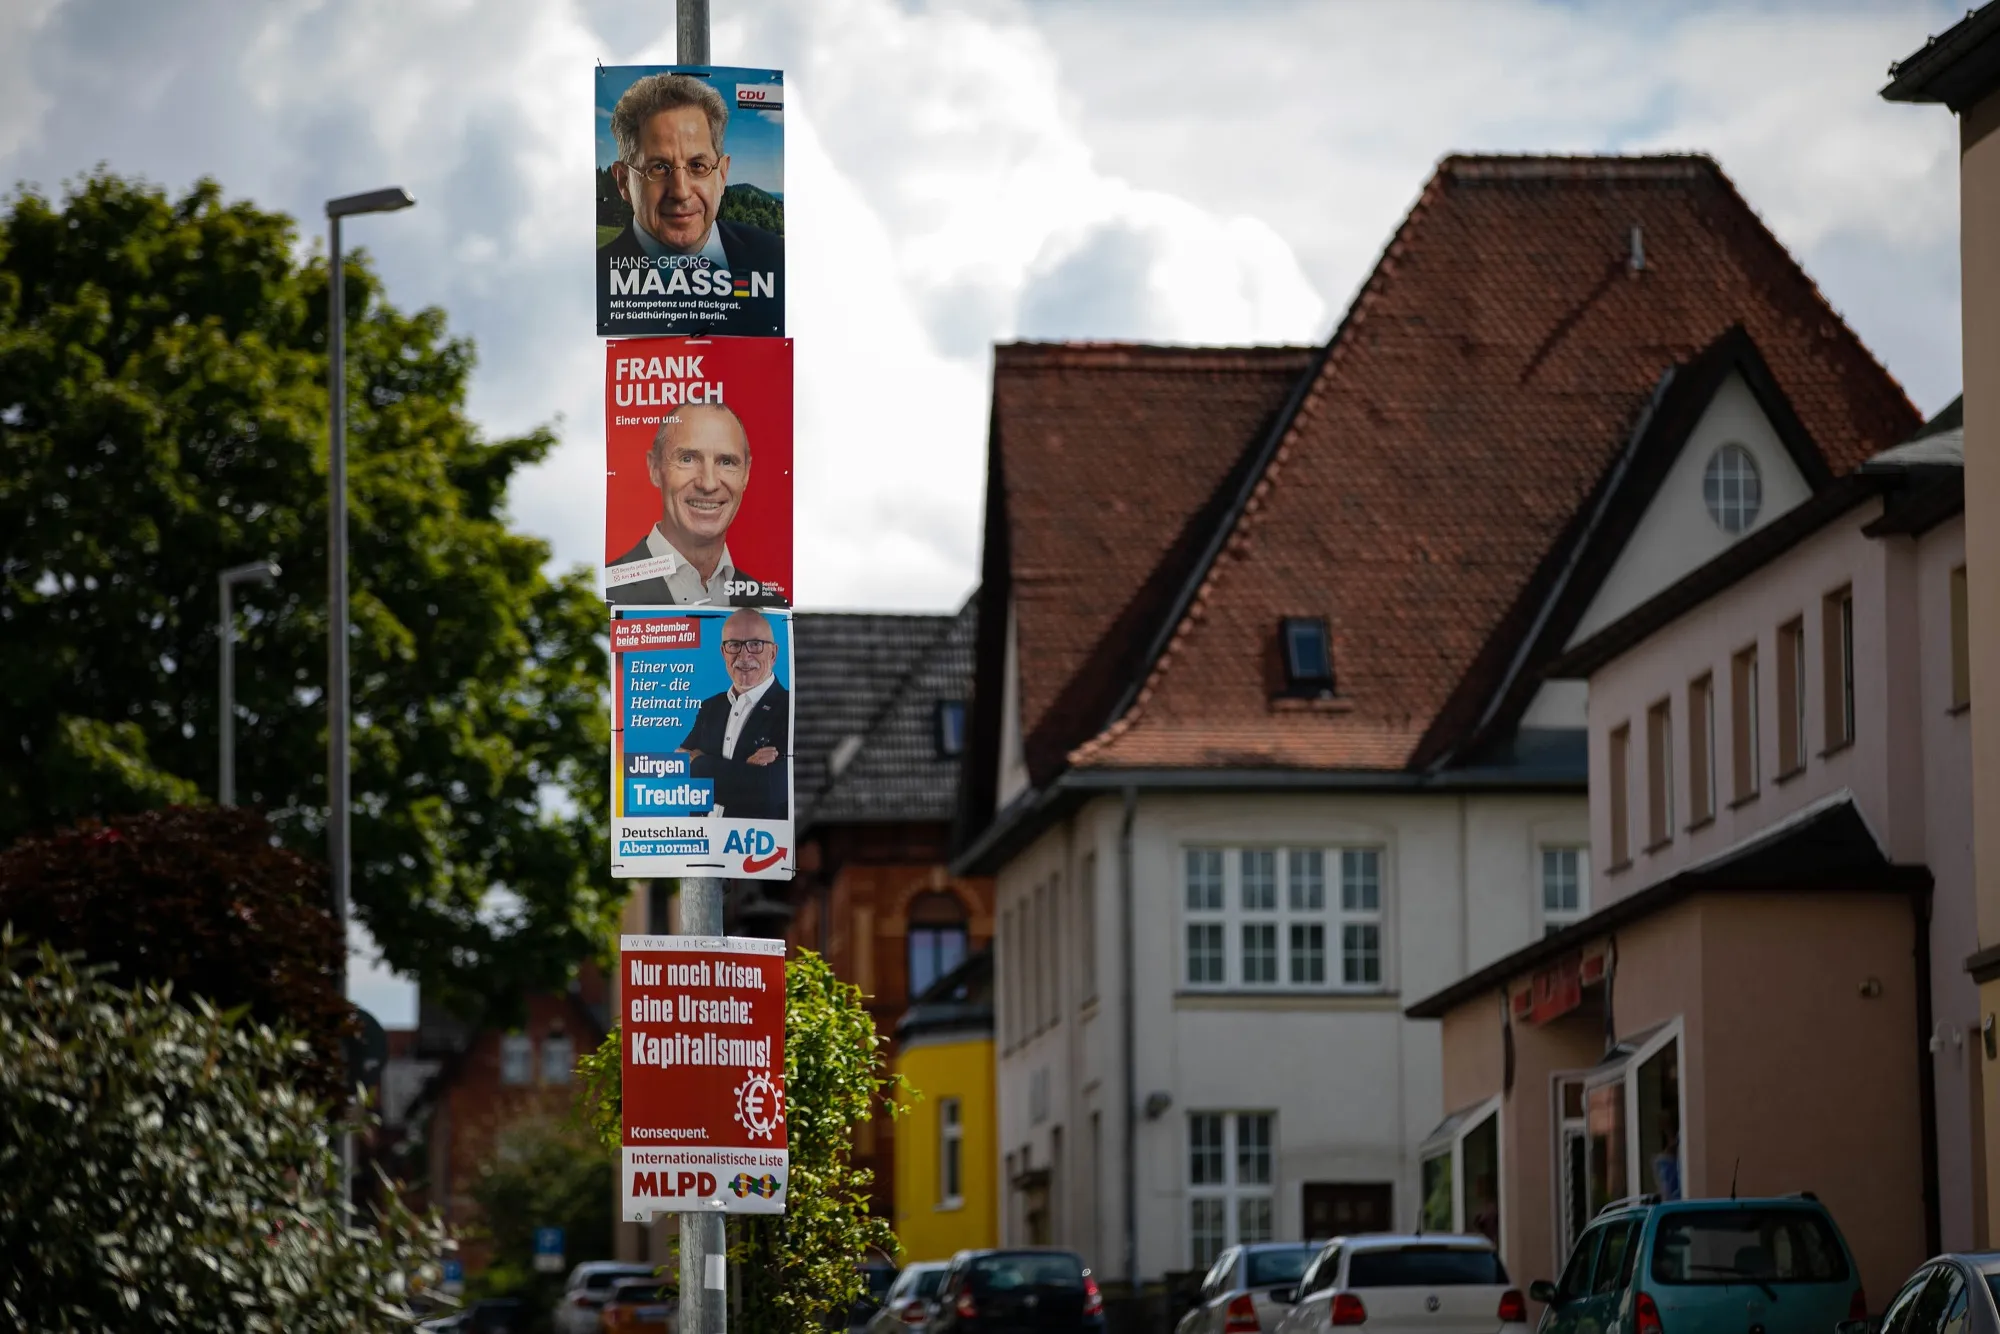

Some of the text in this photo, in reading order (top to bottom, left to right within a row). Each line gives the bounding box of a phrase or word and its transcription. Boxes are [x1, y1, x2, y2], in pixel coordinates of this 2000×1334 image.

[737, 90, 766, 100] CDU
[610, 256, 710, 269] HANS-GEORG
[610, 300, 741, 310] Mit Kompetenz und Rückgrat.
[610, 311, 728, 321] Für Südthüringen in Berlin.
[616, 356, 704, 380] FRANK
[616, 382, 724, 406] ULLRICH
[616, 415, 683, 426] Einer von uns.
[724, 580, 760, 596] SPD
[616, 622, 690, 635] Am 26. September
[616, 632, 696, 646] beide Stimmen AfD!
[630, 660, 694, 673] Einer von
[630, 678, 658, 691] hier
[669, 678, 690, 691] die
[630, 696, 702, 709] Heimat im
[630, 714, 682, 727] Herzen.
[629, 756, 684, 778] Jürgen
[634, 784, 710, 806] Treutler
[622, 827, 708, 838] Deutschland.
[621, 841, 708, 854] Aber normal.
[722, 828, 774, 855] AfD
[630, 960, 766, 992] Nur noch Krisen,
[631, 995, 753, 1024] eine Ursache:
[632, 1032, 771, 1069] Kapitalismus!
[631, 1126, 709, 1140] Konsequent.
[632, 1152, 783, 1166] Internationalistische Liste
[632, 1172, 717, 1197] MLPD
